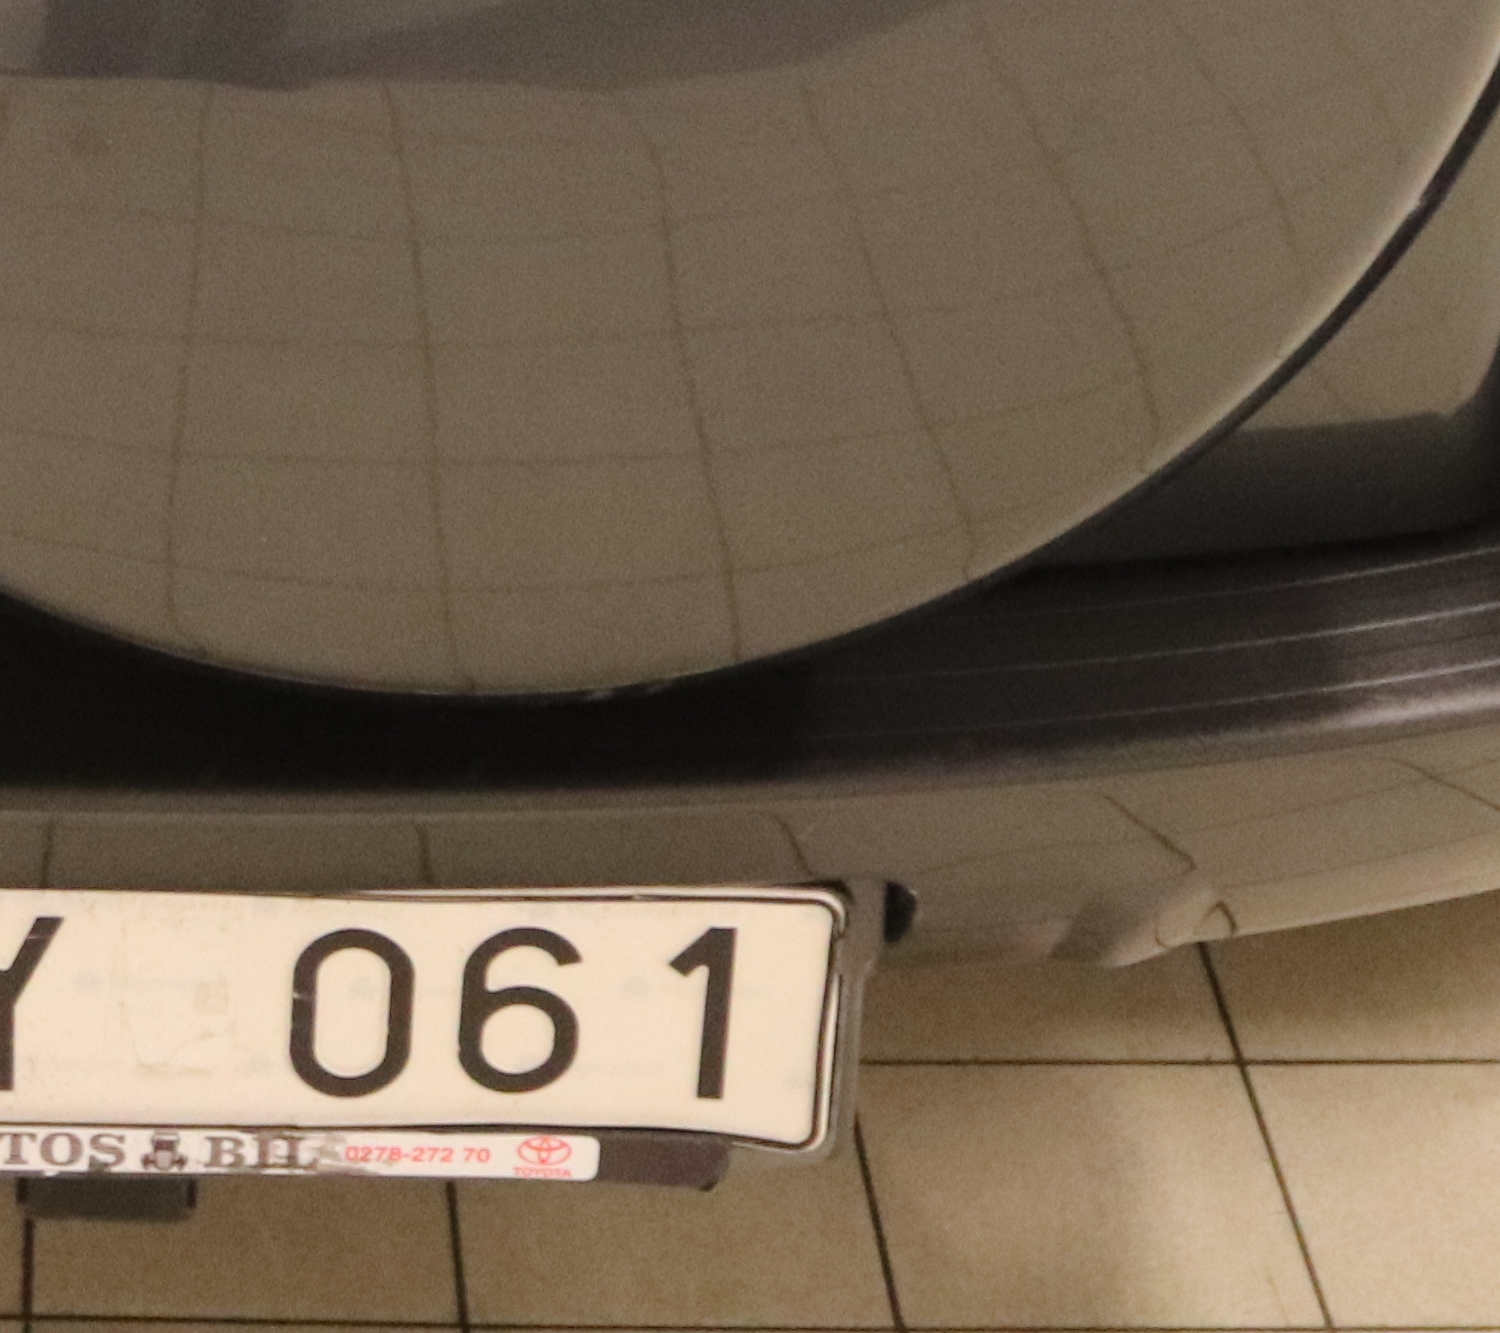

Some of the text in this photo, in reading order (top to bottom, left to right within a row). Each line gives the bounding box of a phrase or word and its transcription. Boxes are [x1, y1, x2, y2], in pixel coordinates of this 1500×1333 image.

[287, 926, 738, 1101] 061
[345, 1145, 491, 1164] 0278-272 70
[513, 1166, 572, 1178] TOYOTA
